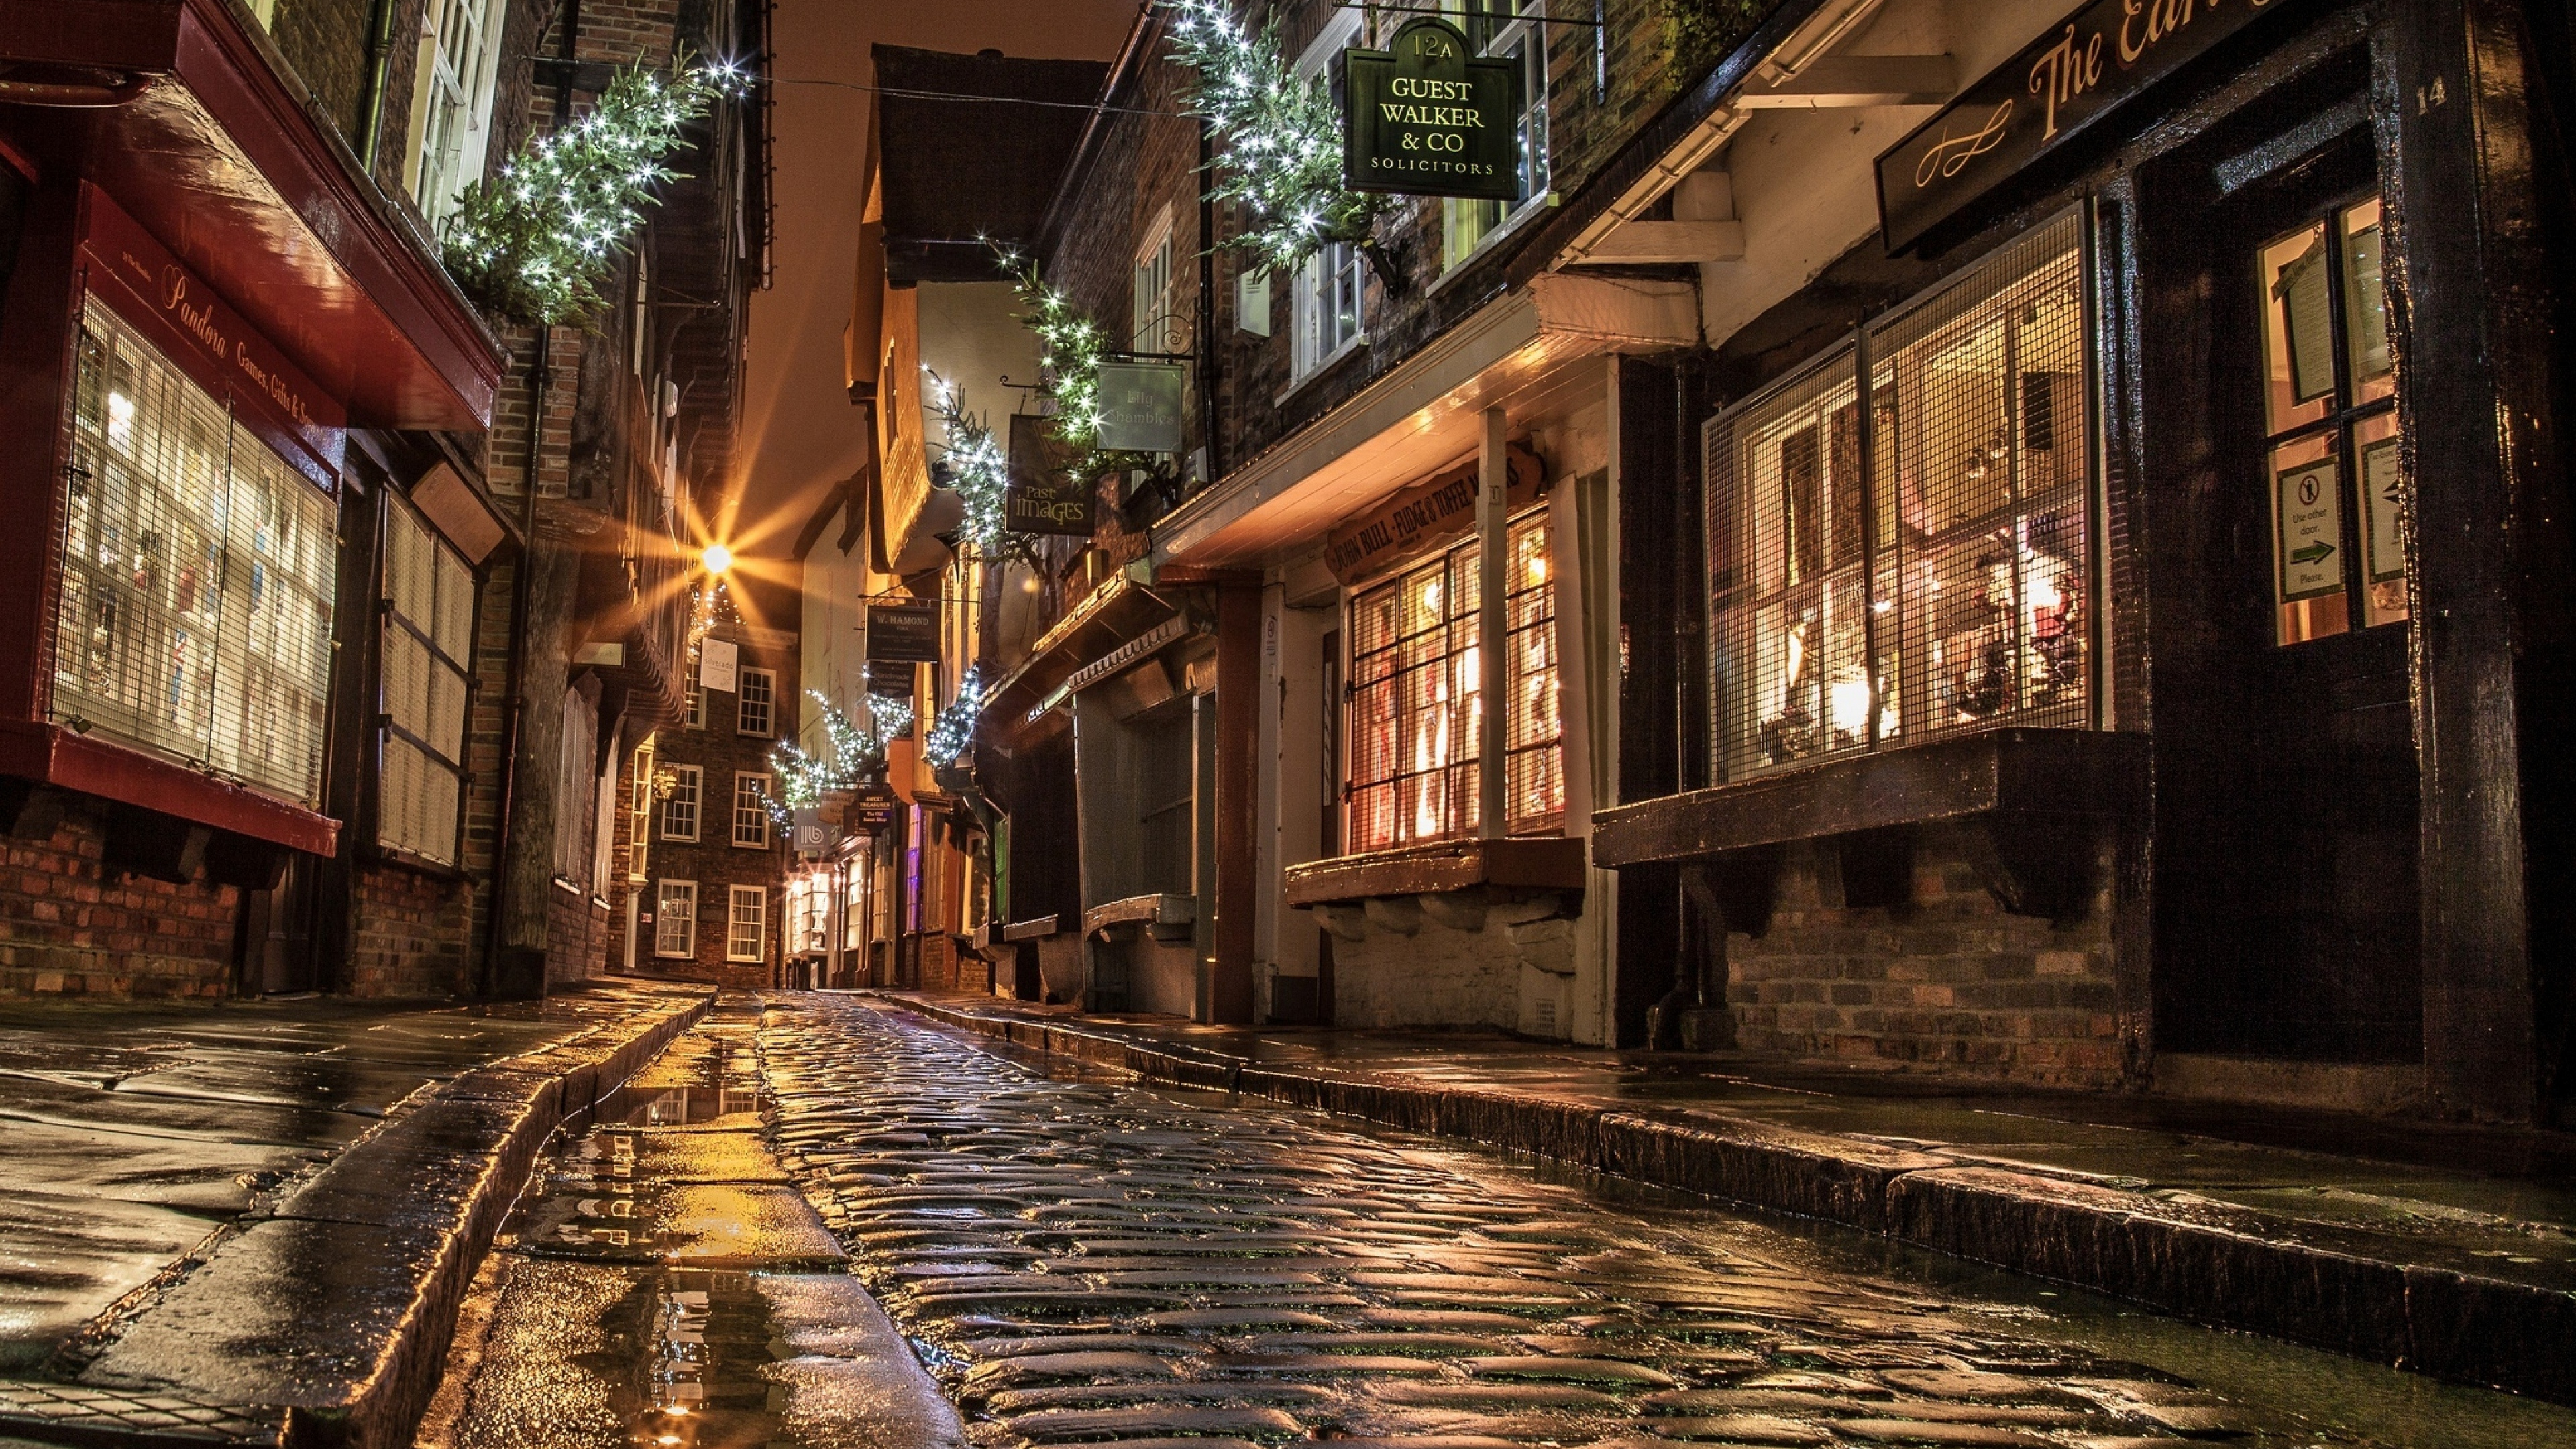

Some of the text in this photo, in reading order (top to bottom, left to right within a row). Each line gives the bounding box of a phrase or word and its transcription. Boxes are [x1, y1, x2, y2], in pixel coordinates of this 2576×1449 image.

[1413, 35, 1452, 58] 12A
[1391, 77, 1472, 101] GUEST
[2029, 23, 2102, 142] The
[2416, 76, 2447, 115] 14
[1379, 103, 1485, 128] WALKER
[1401, 133, 1464, 152] & CO
[1371, 157, 1493, 175] SOLICITORS
[160, 264, 229, 359] Pandora
[271, 374, 290, 412] Gifts
[1026, 486, 1057, 499] Past
[1334, 536, 1363, 571] JOHN
[1358, 521, 1394, 556] BULL
[1432, 478, 1472, 517] TOFFEE
[2292, 508, 2327, 523] Use other
